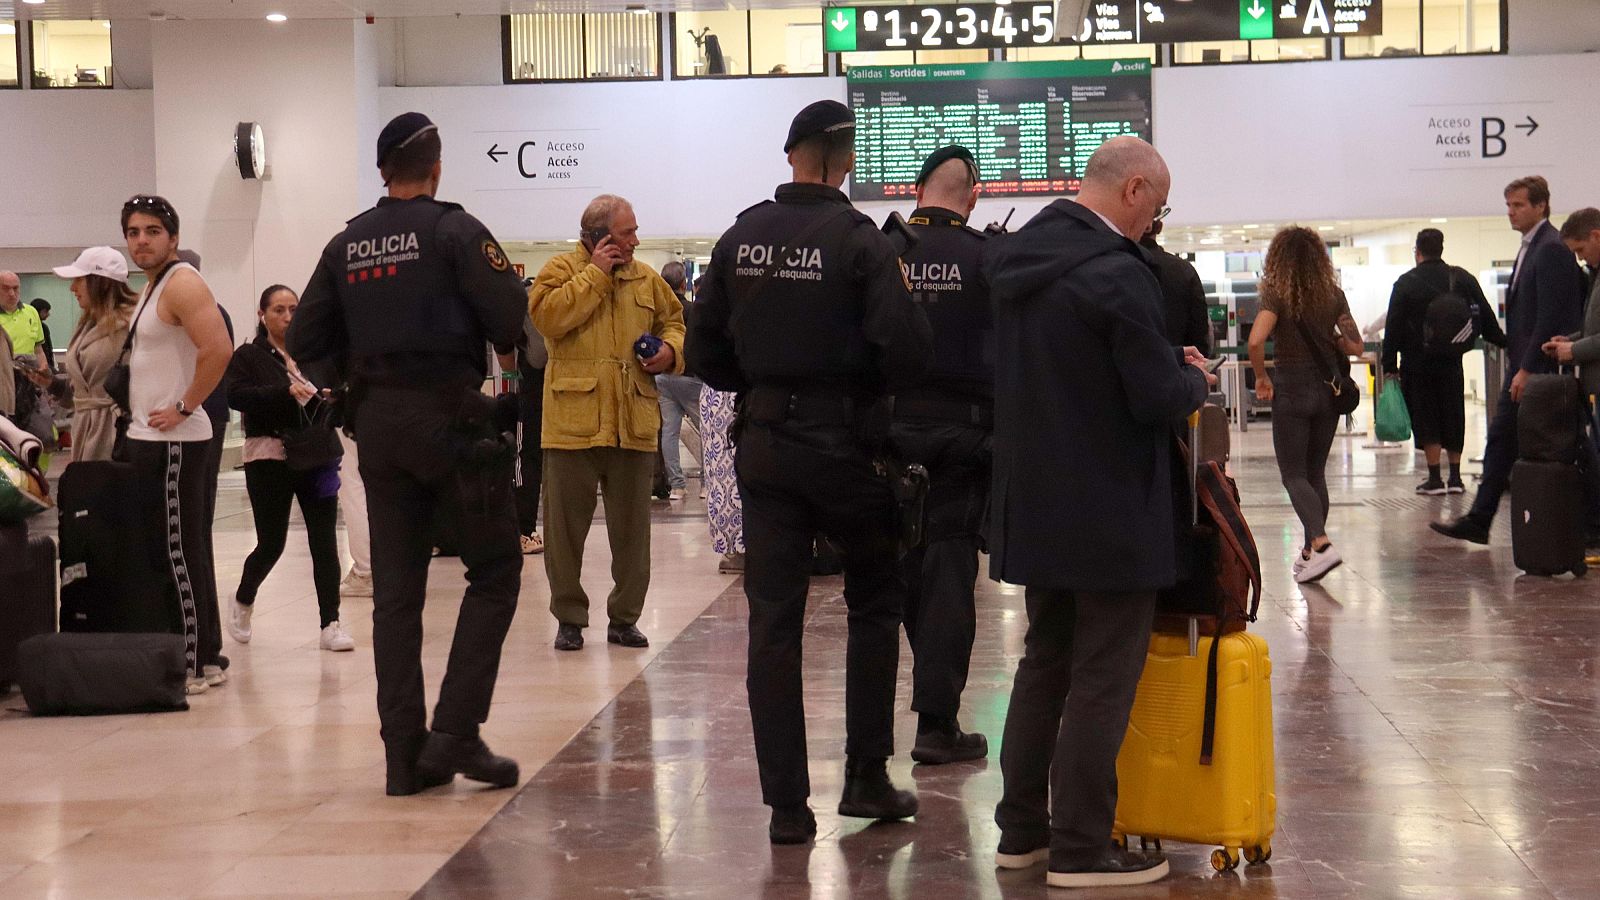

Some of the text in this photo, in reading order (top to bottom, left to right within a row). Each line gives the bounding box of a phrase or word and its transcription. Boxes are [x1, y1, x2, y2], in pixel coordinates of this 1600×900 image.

[1303, 0, 1329, 34] A
[1123, 62, 1146, 71] adif
[852, 68, 966, 79] Salidas Sortides DEPARTURES
[1428, 117, 1471, 129] Acceso
[1435, 132, 1471, 145] Accés
[1481, 117, 1507, 158] B
[547, 141, 585, 151] Acceso
[517, 141, 537, 179] C
[1444, 150, 1471, 158] ACCESS
[547, 155, 579, 167] Accés
[547, 171, 571, 179] ACCESS
[346, 232, 420, 261] POLICIA
[736, 244, 822, 269] POLCIA
[347, 258, 375, 271] mossos
[736, 267, 765, 277] mosso
